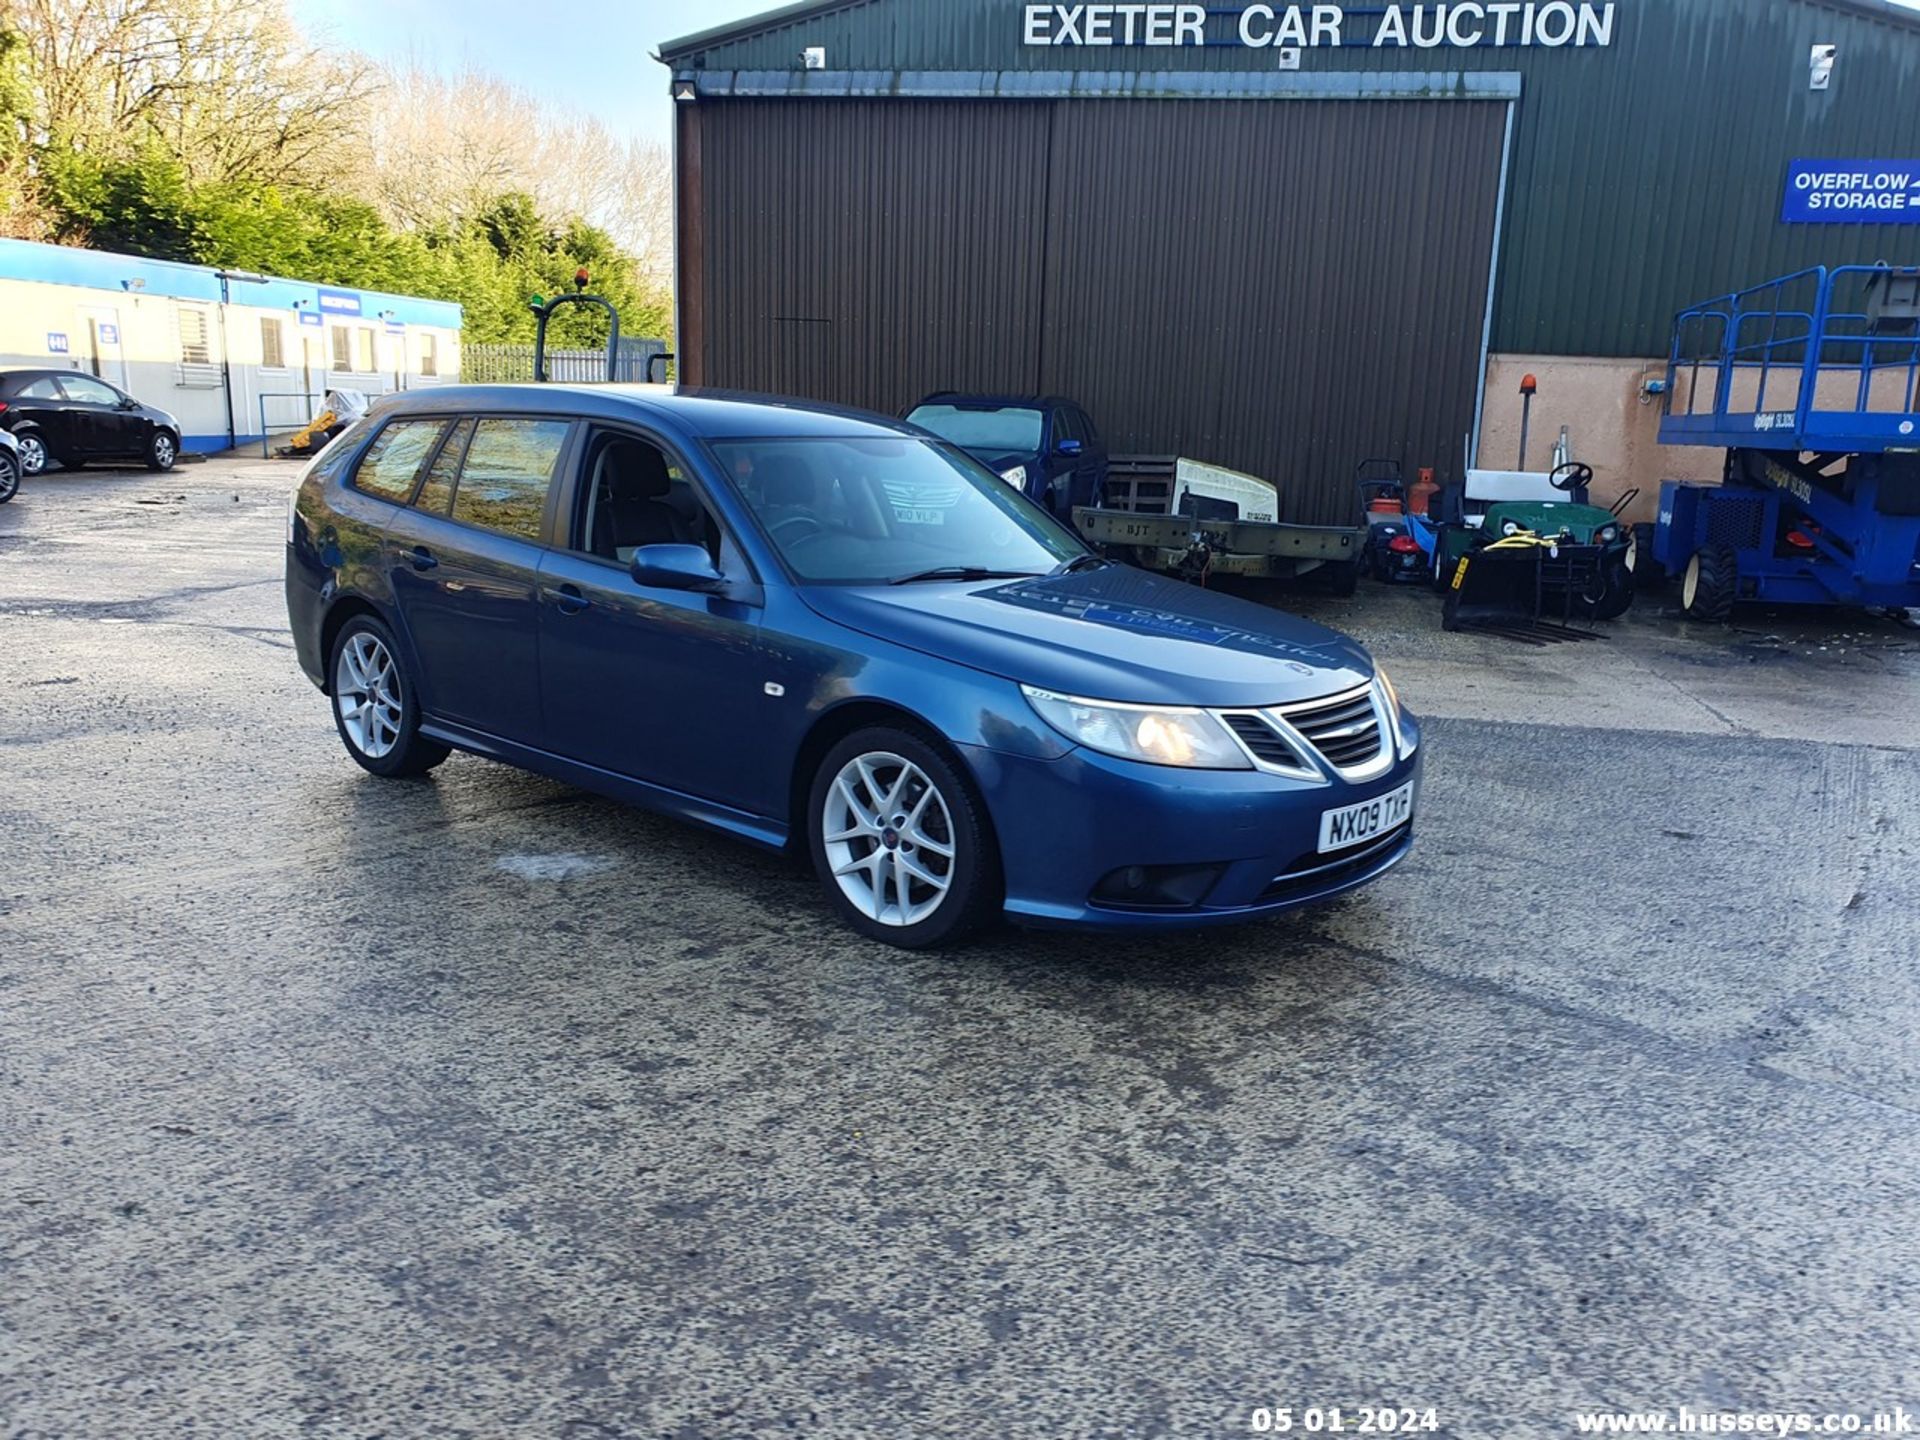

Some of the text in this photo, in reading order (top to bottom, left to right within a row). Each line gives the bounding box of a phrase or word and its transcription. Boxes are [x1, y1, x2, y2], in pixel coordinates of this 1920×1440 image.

[1023, 1, 1614, 47] EXETER CAR AUCTION
[1795, 172, 1910, 190] OVERFLOW
[1808, 191, 1906, 210] STORAGE
[1330, 802, 1380, 844] NX09
